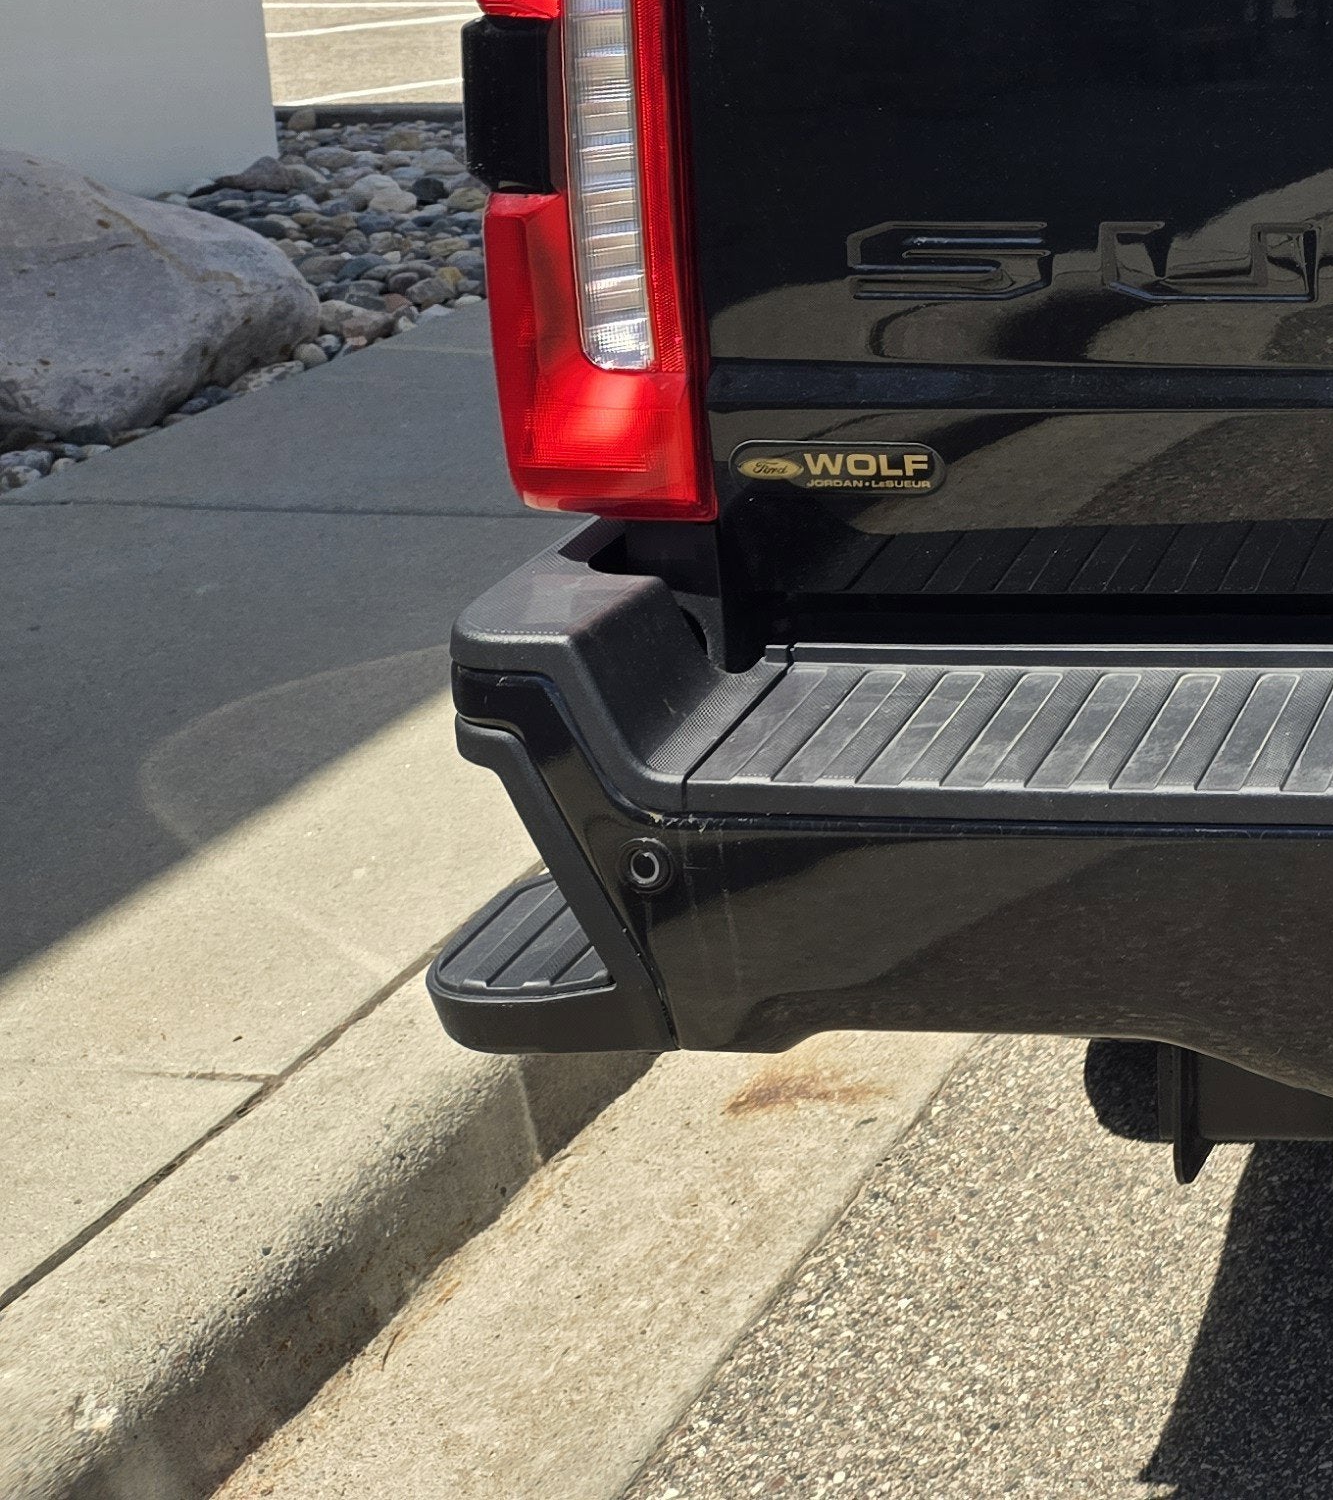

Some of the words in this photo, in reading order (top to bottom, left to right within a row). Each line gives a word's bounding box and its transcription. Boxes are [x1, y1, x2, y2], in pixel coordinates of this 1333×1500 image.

[752, 461, 788, 475] Ford
[804, 453, 928, 476] WOLF
[806, 479, 863, 488] JORDAN
